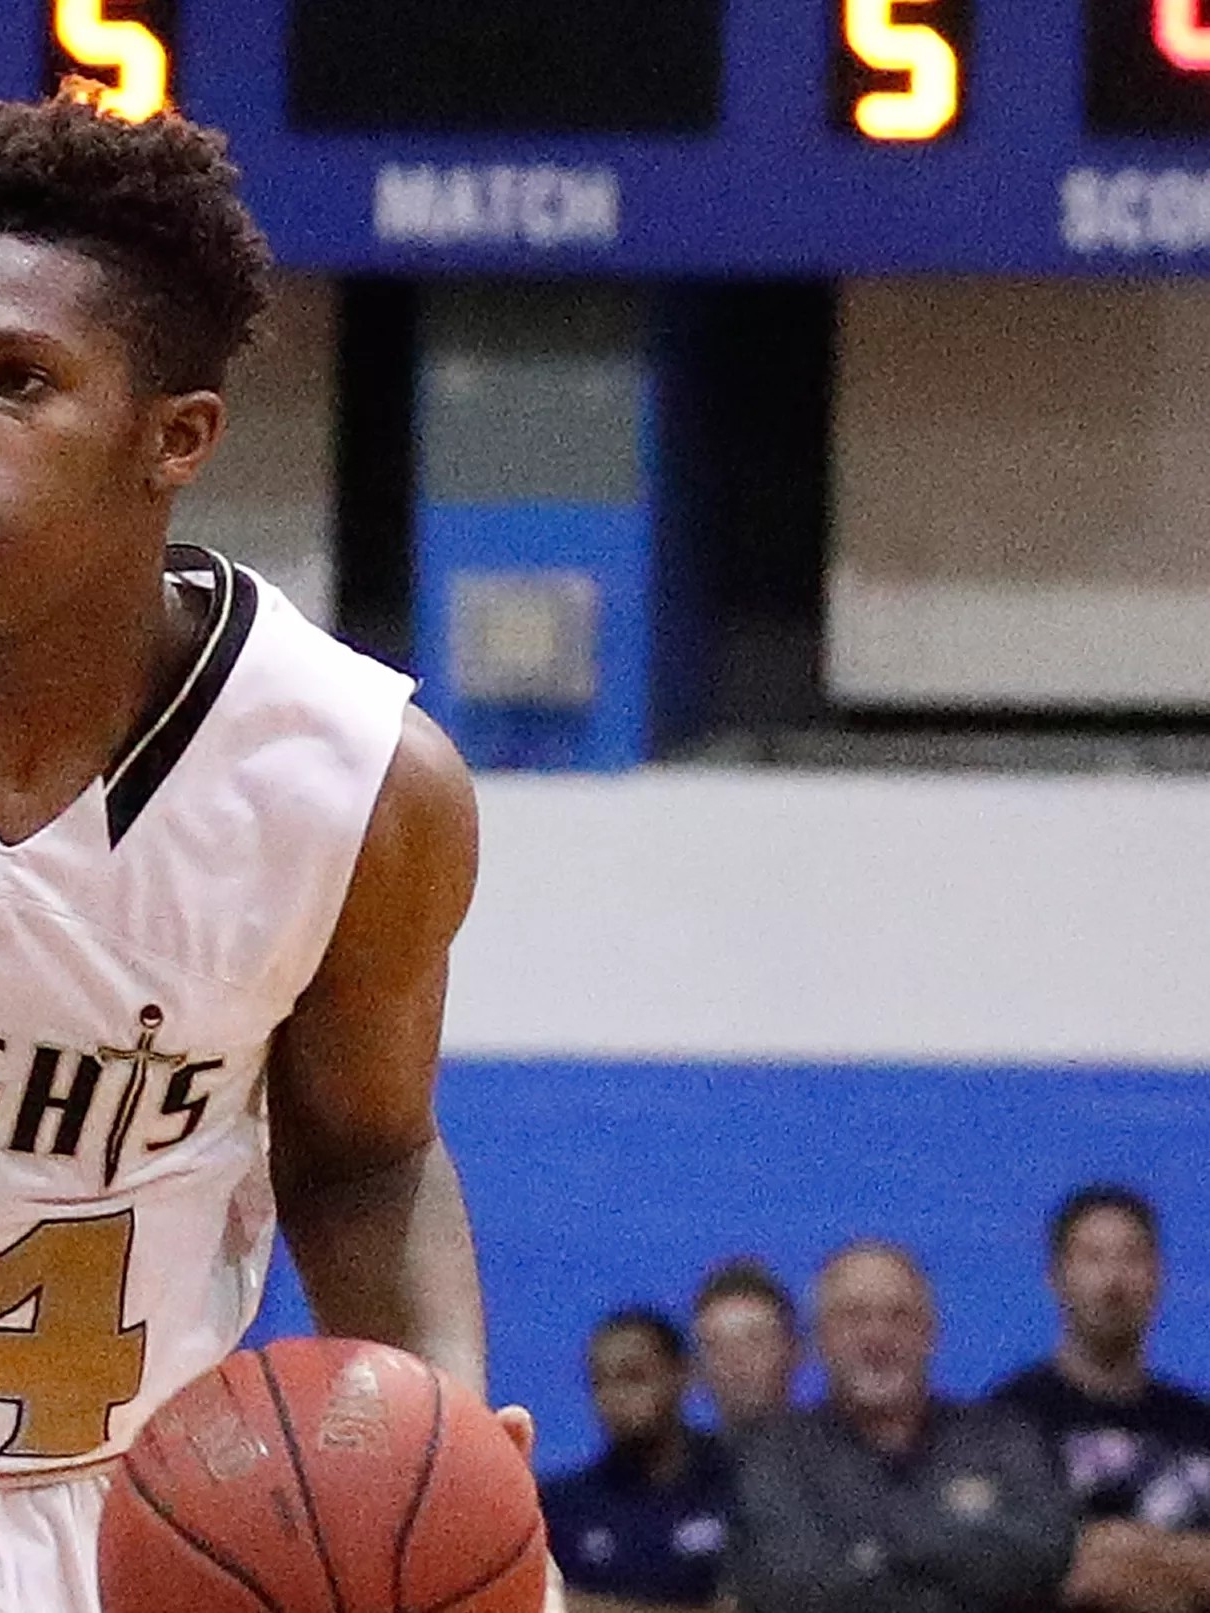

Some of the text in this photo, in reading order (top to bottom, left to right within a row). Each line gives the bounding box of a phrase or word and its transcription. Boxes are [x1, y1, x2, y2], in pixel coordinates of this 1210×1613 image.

[54, 0, 168, 126] 5
[844, 0, 958, 141] 5
[374, 160, 620, 245] MATCH
[1062, 166, 1210, 252] SCO
